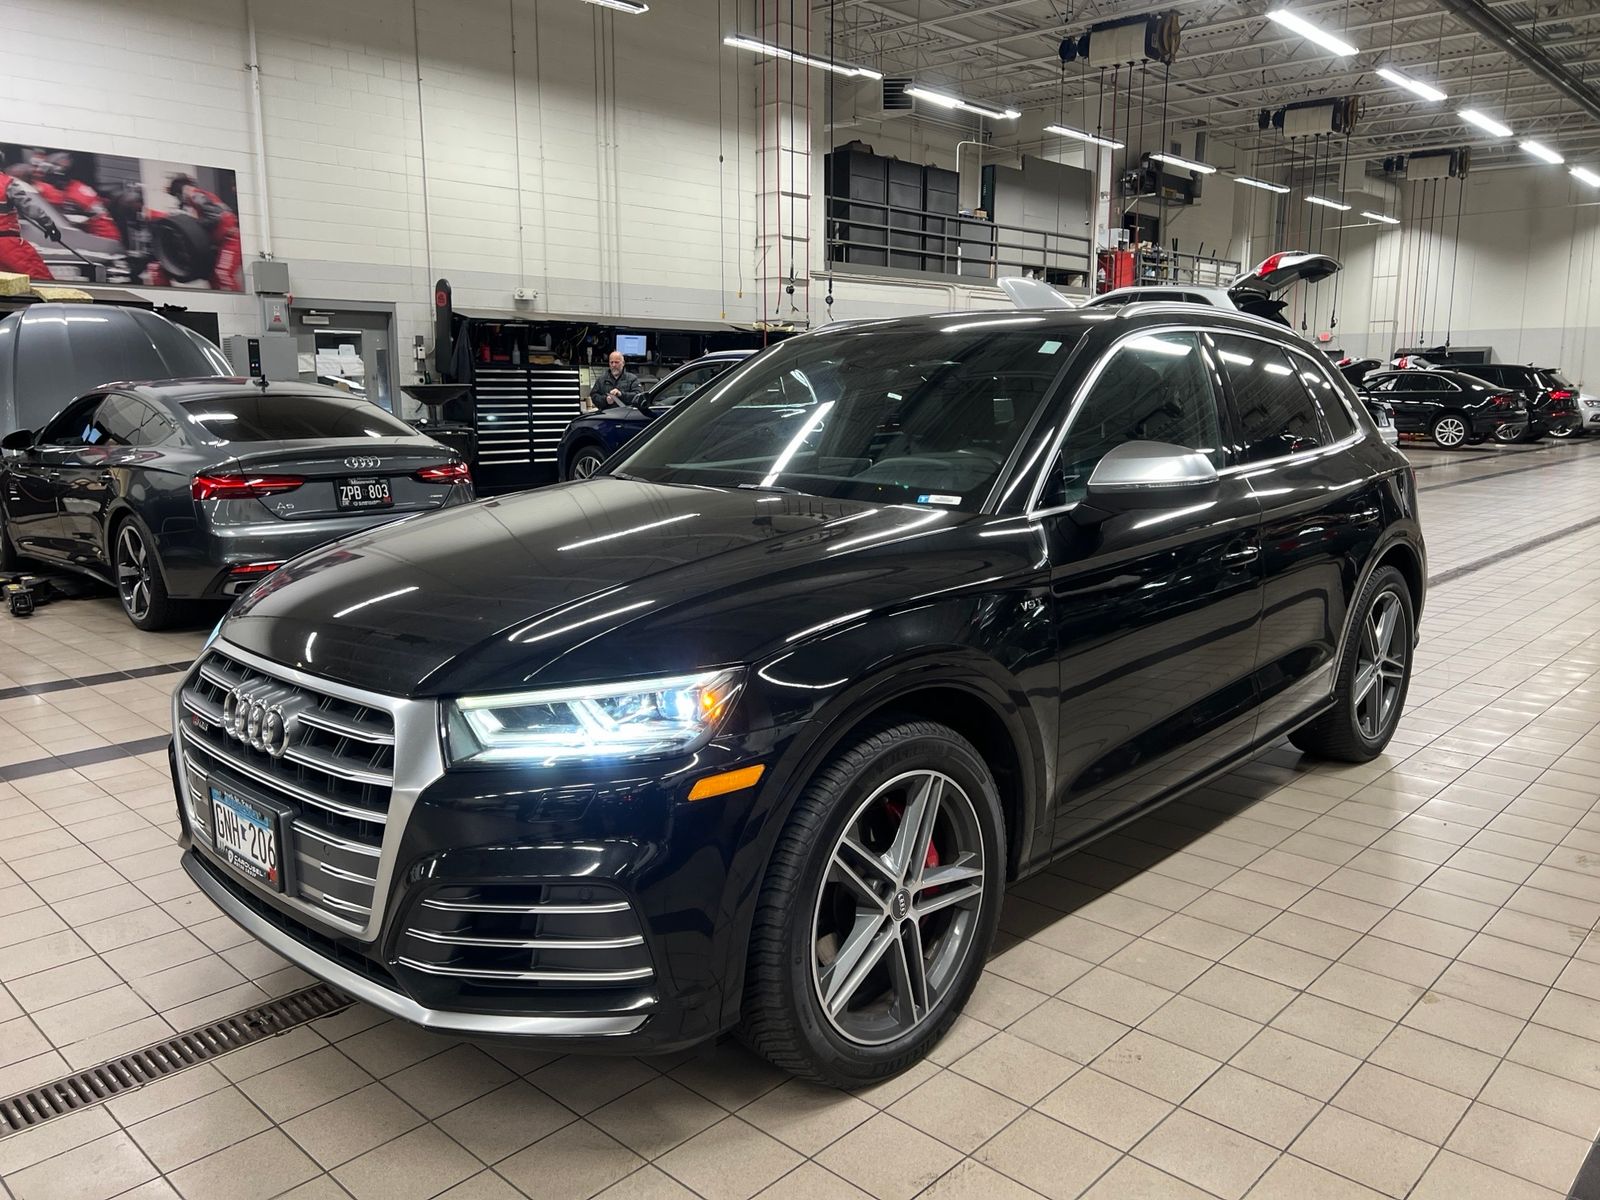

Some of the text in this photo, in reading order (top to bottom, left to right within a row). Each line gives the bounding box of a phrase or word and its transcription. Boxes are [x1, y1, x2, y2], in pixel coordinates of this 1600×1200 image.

[340, 484, 389, 501] ZPB 803
[277, 502, 295, 510] A5
[215, 803, 276, 869] GNH 206
[233, 854, 264, 877] CAROUSEL
